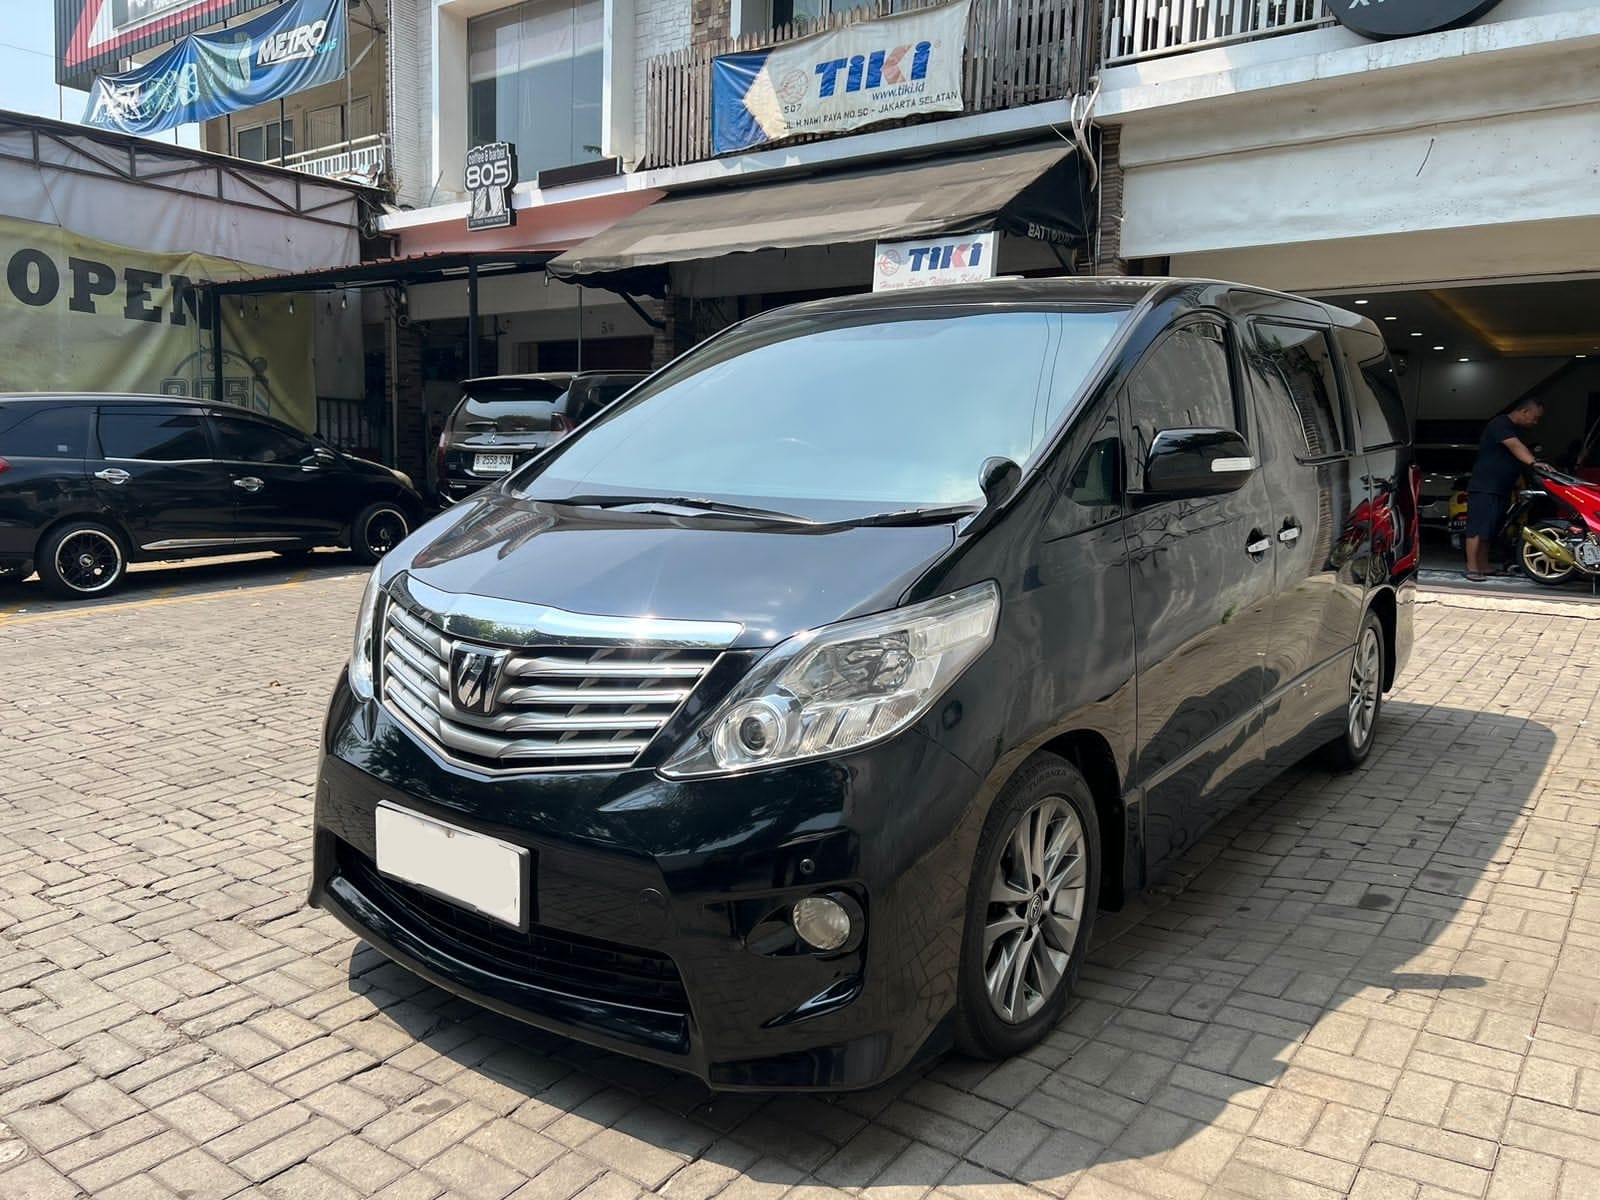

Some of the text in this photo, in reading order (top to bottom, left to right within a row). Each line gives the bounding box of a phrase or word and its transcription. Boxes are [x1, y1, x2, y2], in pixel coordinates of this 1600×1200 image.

[257, 19, 327, 64] METRO
[871, 82, 925, 100] www.tiki.id
[878, 98, 917, 113] JAKARTA
[919, 90, 958, 105] SELATAN
[466, 159, 509, 189] 805
[6, 248, 213, 330] OPEN
